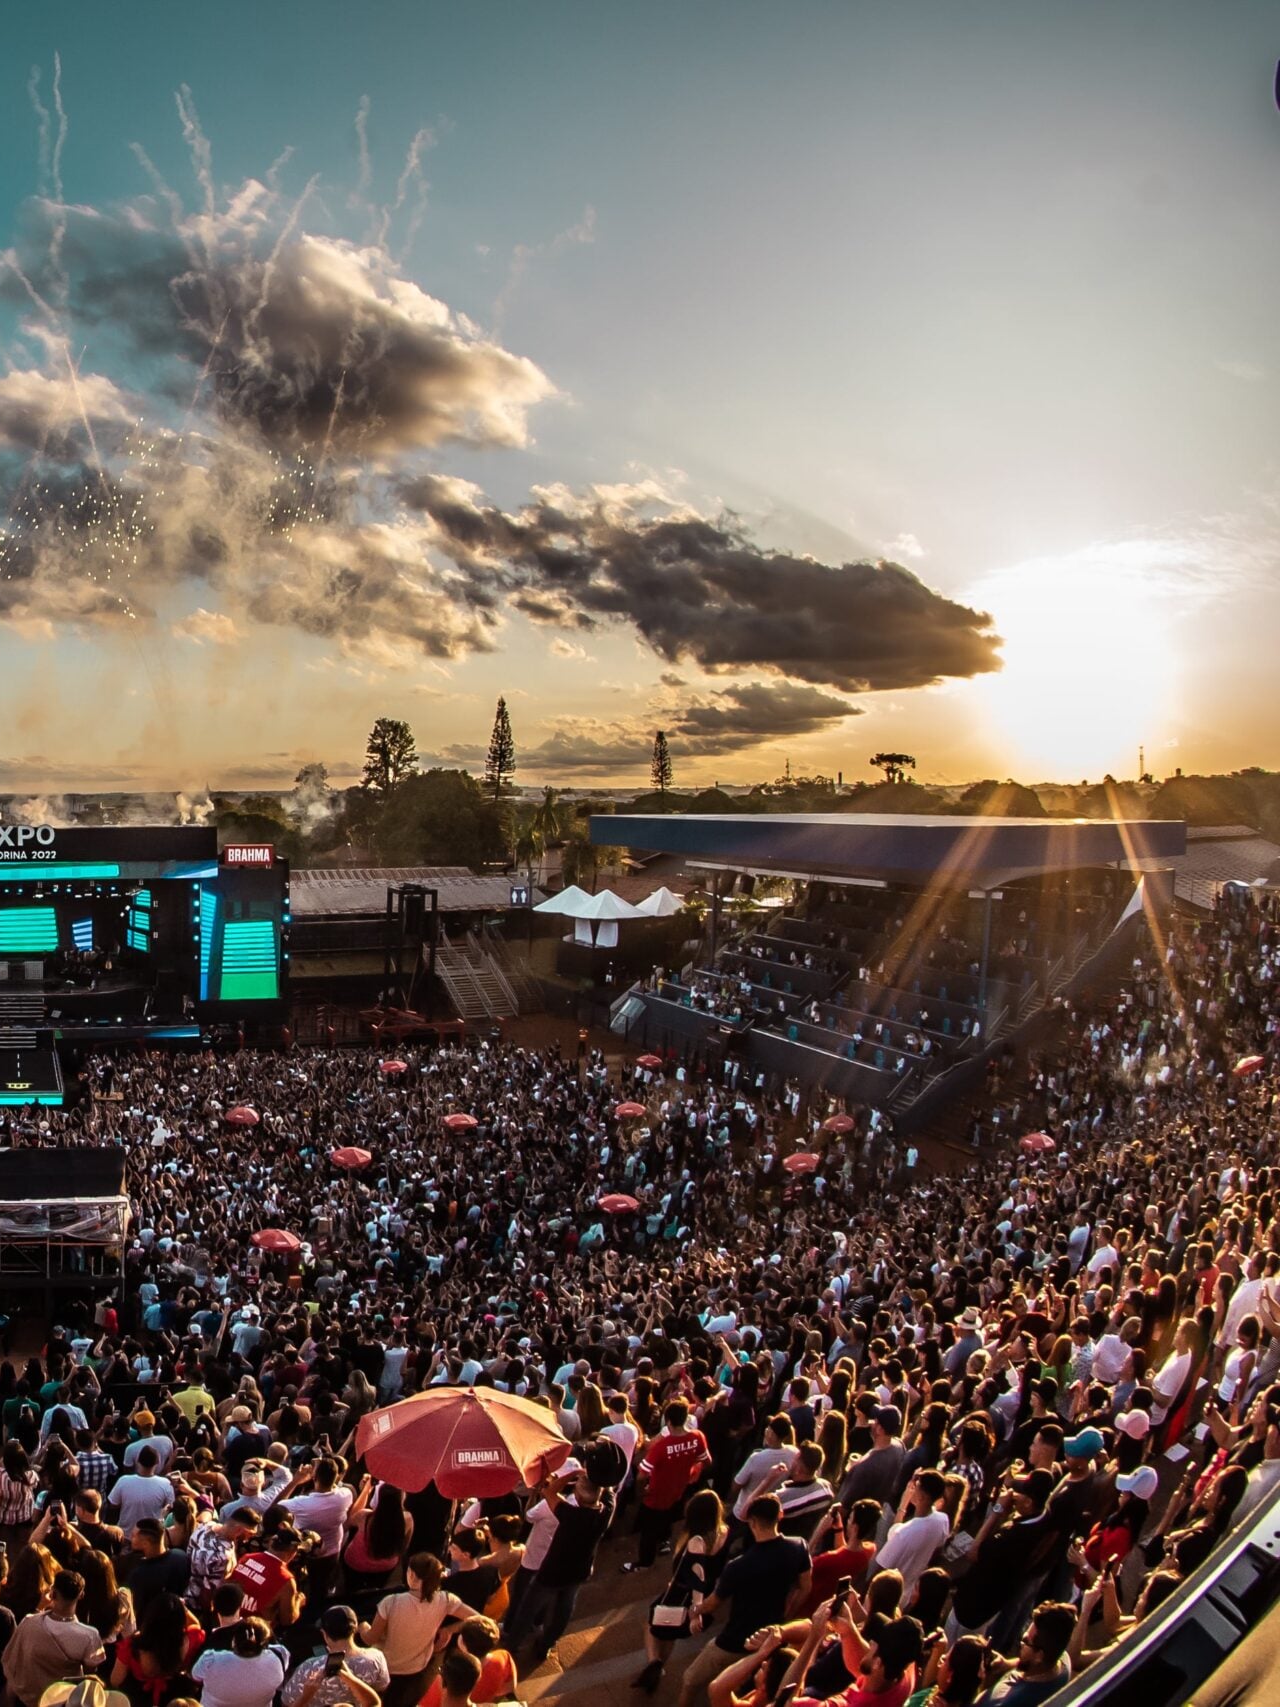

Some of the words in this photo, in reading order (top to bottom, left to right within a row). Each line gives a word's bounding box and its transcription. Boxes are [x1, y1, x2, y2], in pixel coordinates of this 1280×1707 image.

[31, 851, 56, 860] 2022
[228, 848, 270, 862] BRAHMA
[666, 1439, 698, 1454] BULLS
[458, 1450, 500, 1463] BRAHMA
